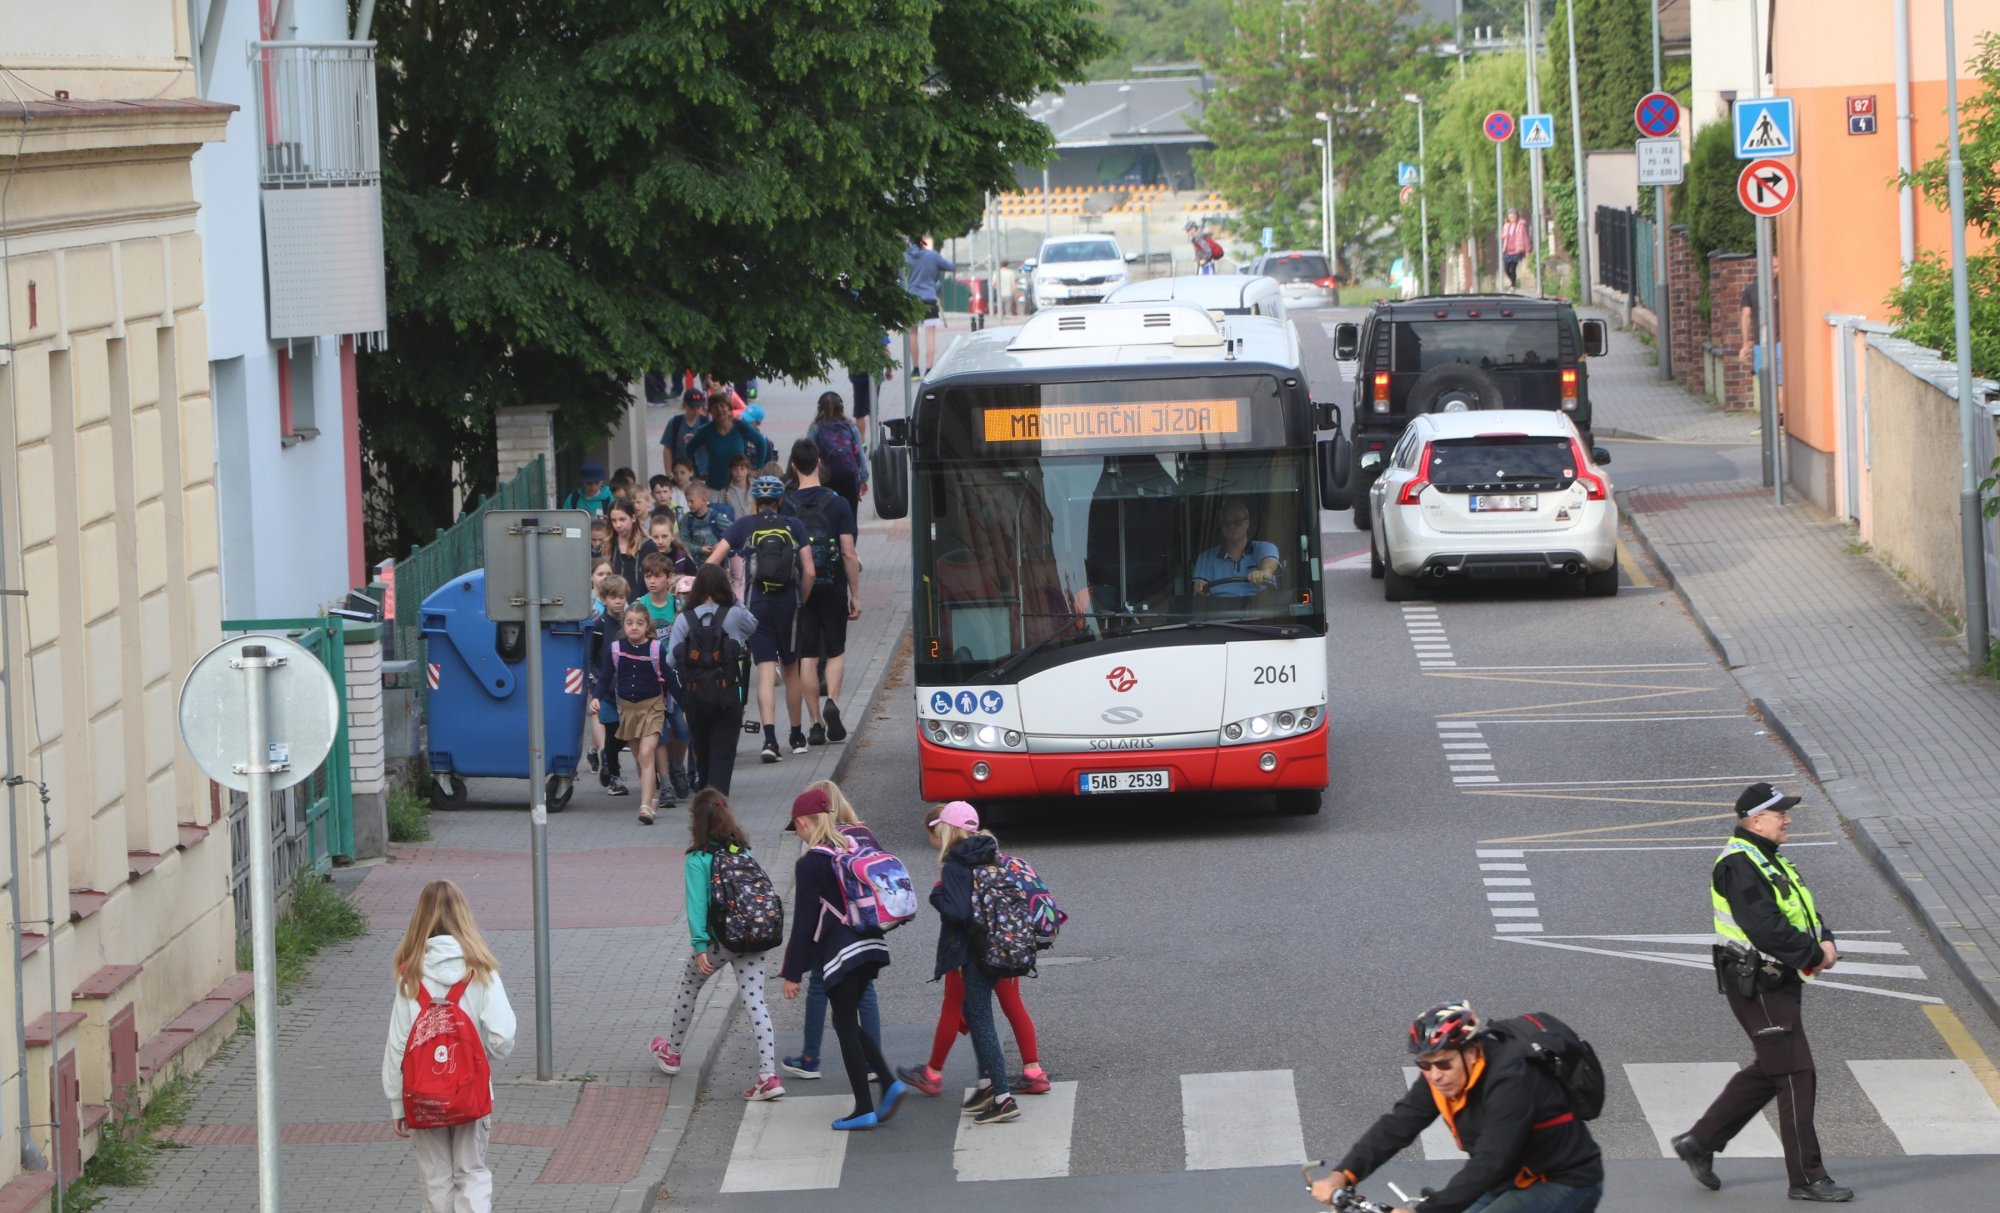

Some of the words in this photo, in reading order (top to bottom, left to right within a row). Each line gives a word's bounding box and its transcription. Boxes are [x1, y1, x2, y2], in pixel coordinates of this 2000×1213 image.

[1855, 99, 1869, 112] 97
[1859, 118, 1866, 131] 4
[1011, 405, 1142, 438] MANIPULAČNÍ
[1151, 404, 1211, 434] JÍZDA
[931, 641, 938, 658] 2
[1253, 664, 1296, 685] 2061
[1089, 738, 1154, 751] SOLARIS
[1091, 775, 1117, 789] 5AB
[1128, 773, 1162, 788] 2539
